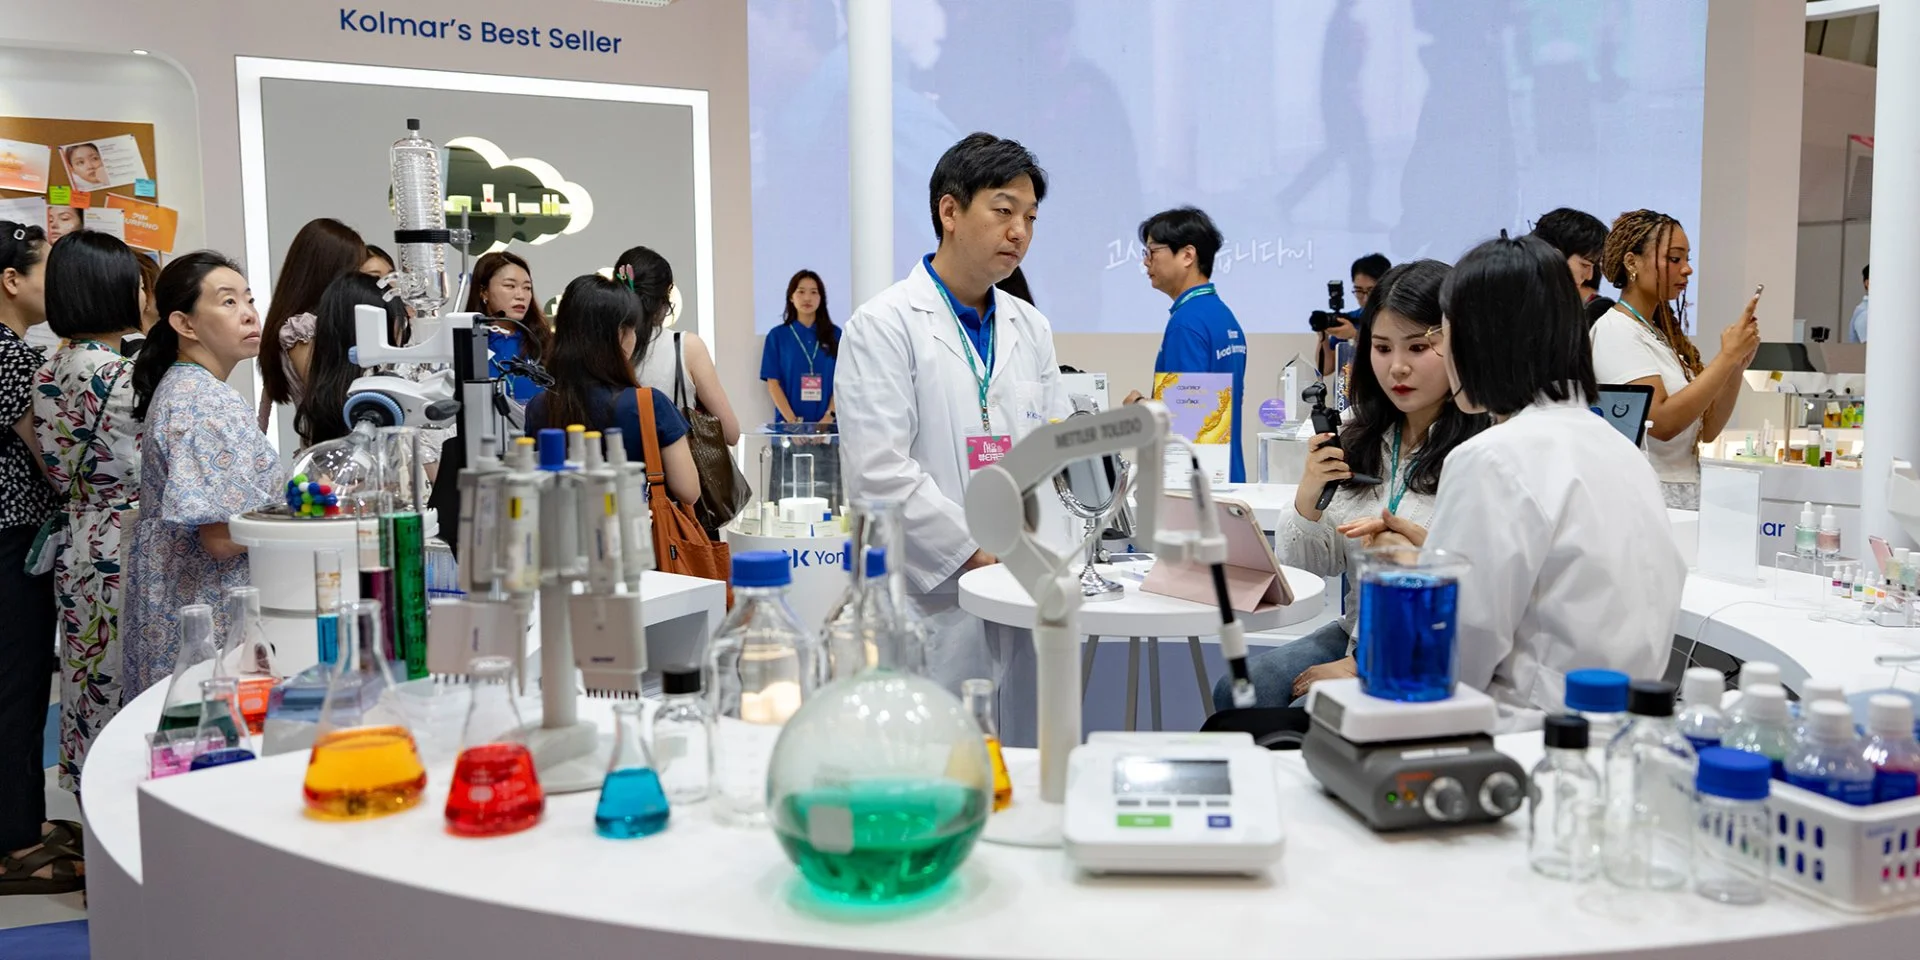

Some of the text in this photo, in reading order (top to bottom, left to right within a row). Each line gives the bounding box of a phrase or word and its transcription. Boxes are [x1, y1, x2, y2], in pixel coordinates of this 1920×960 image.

[339, 8, 622, 54] Kolmar's Best Seller
[1760, 522, 1786, 538] ar
